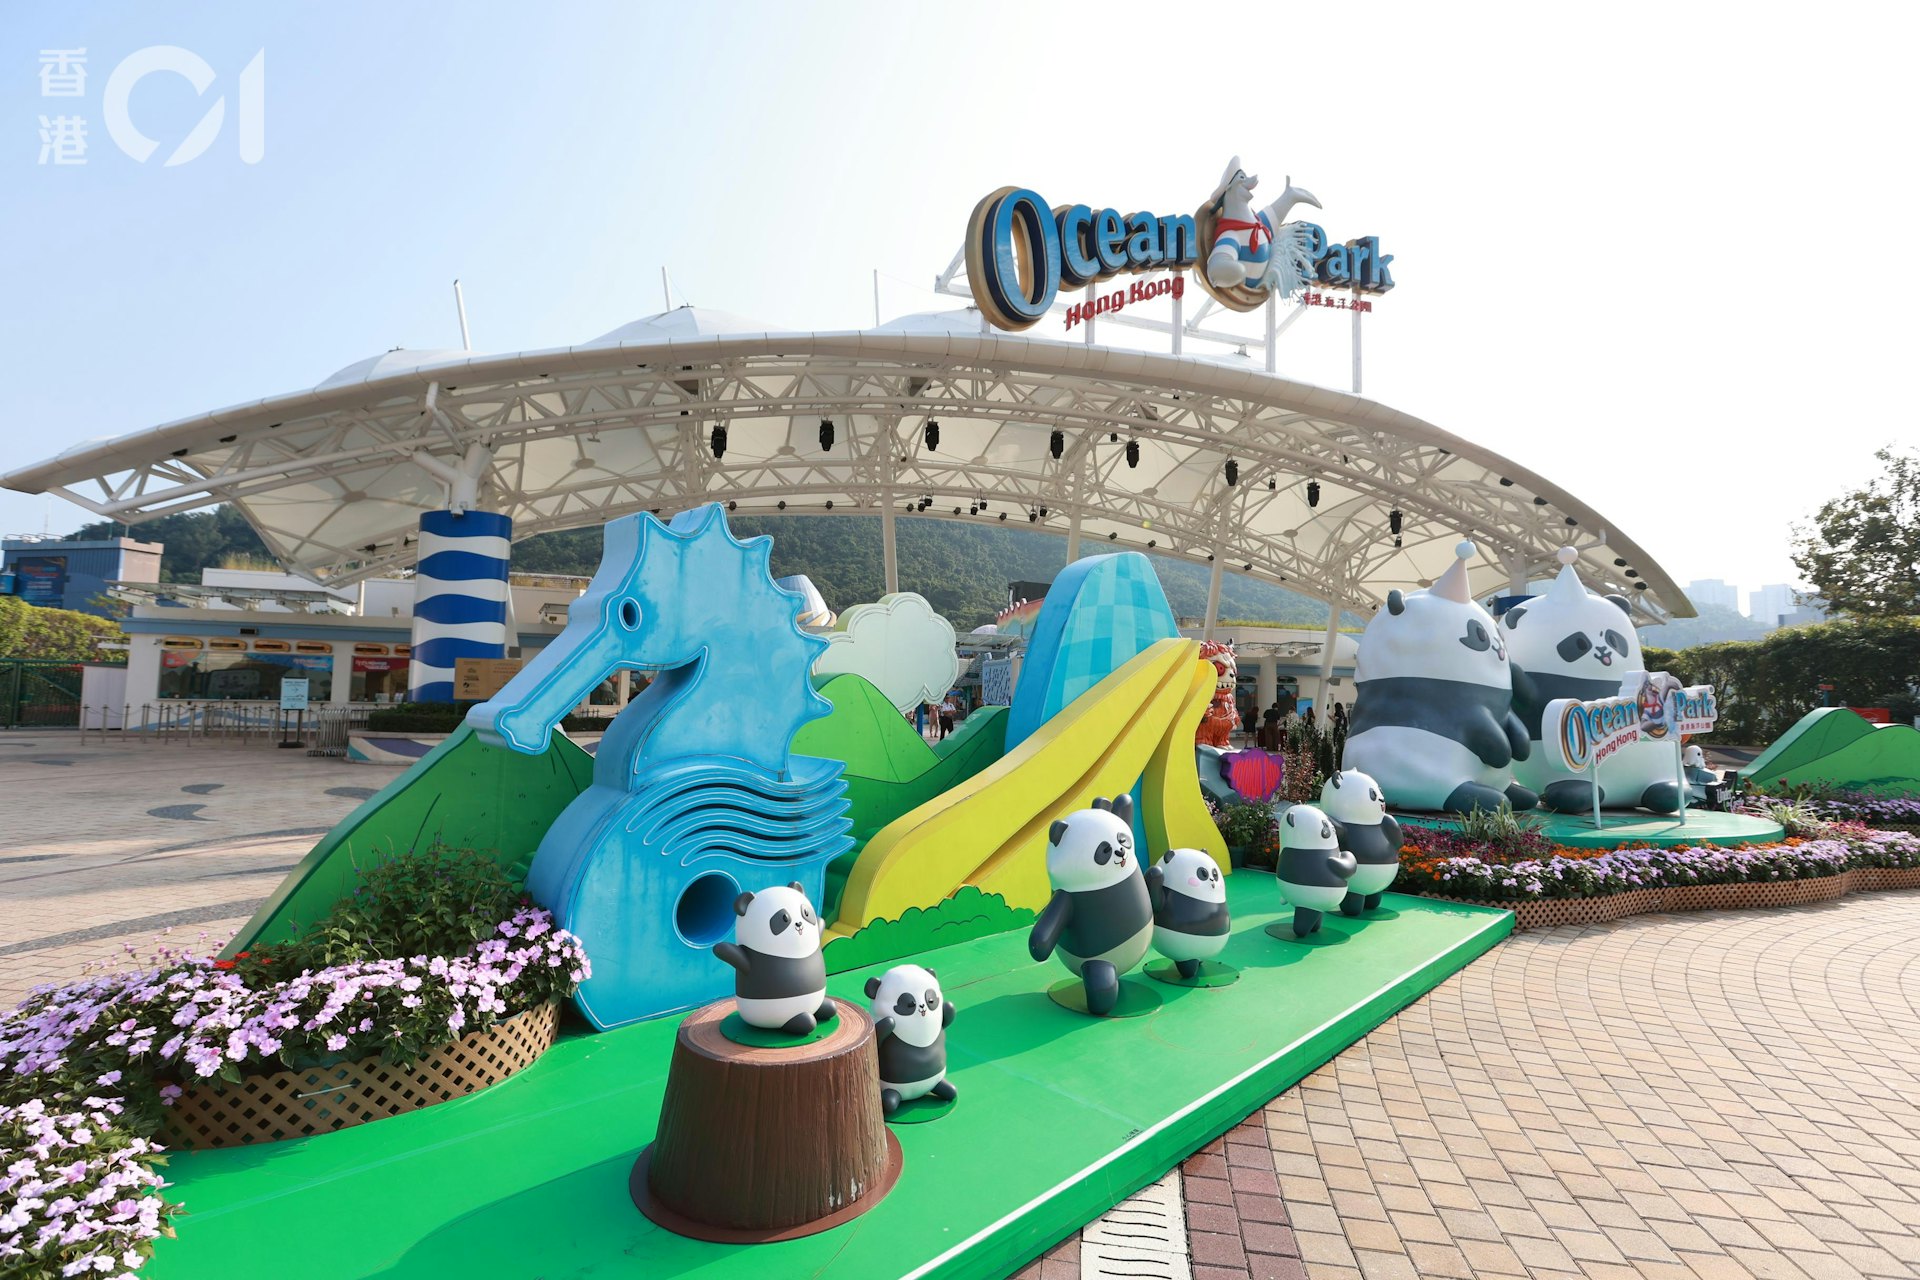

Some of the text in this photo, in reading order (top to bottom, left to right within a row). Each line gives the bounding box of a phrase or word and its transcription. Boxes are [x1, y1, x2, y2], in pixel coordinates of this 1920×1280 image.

[966, 186, 1395, 331] Ocean Park
[1065, 276, 1184, 331] Hong Kong
[1560, 690, 1714, 769] Ocean Park
[1595, 730, 1638, 764] Hong Kong
